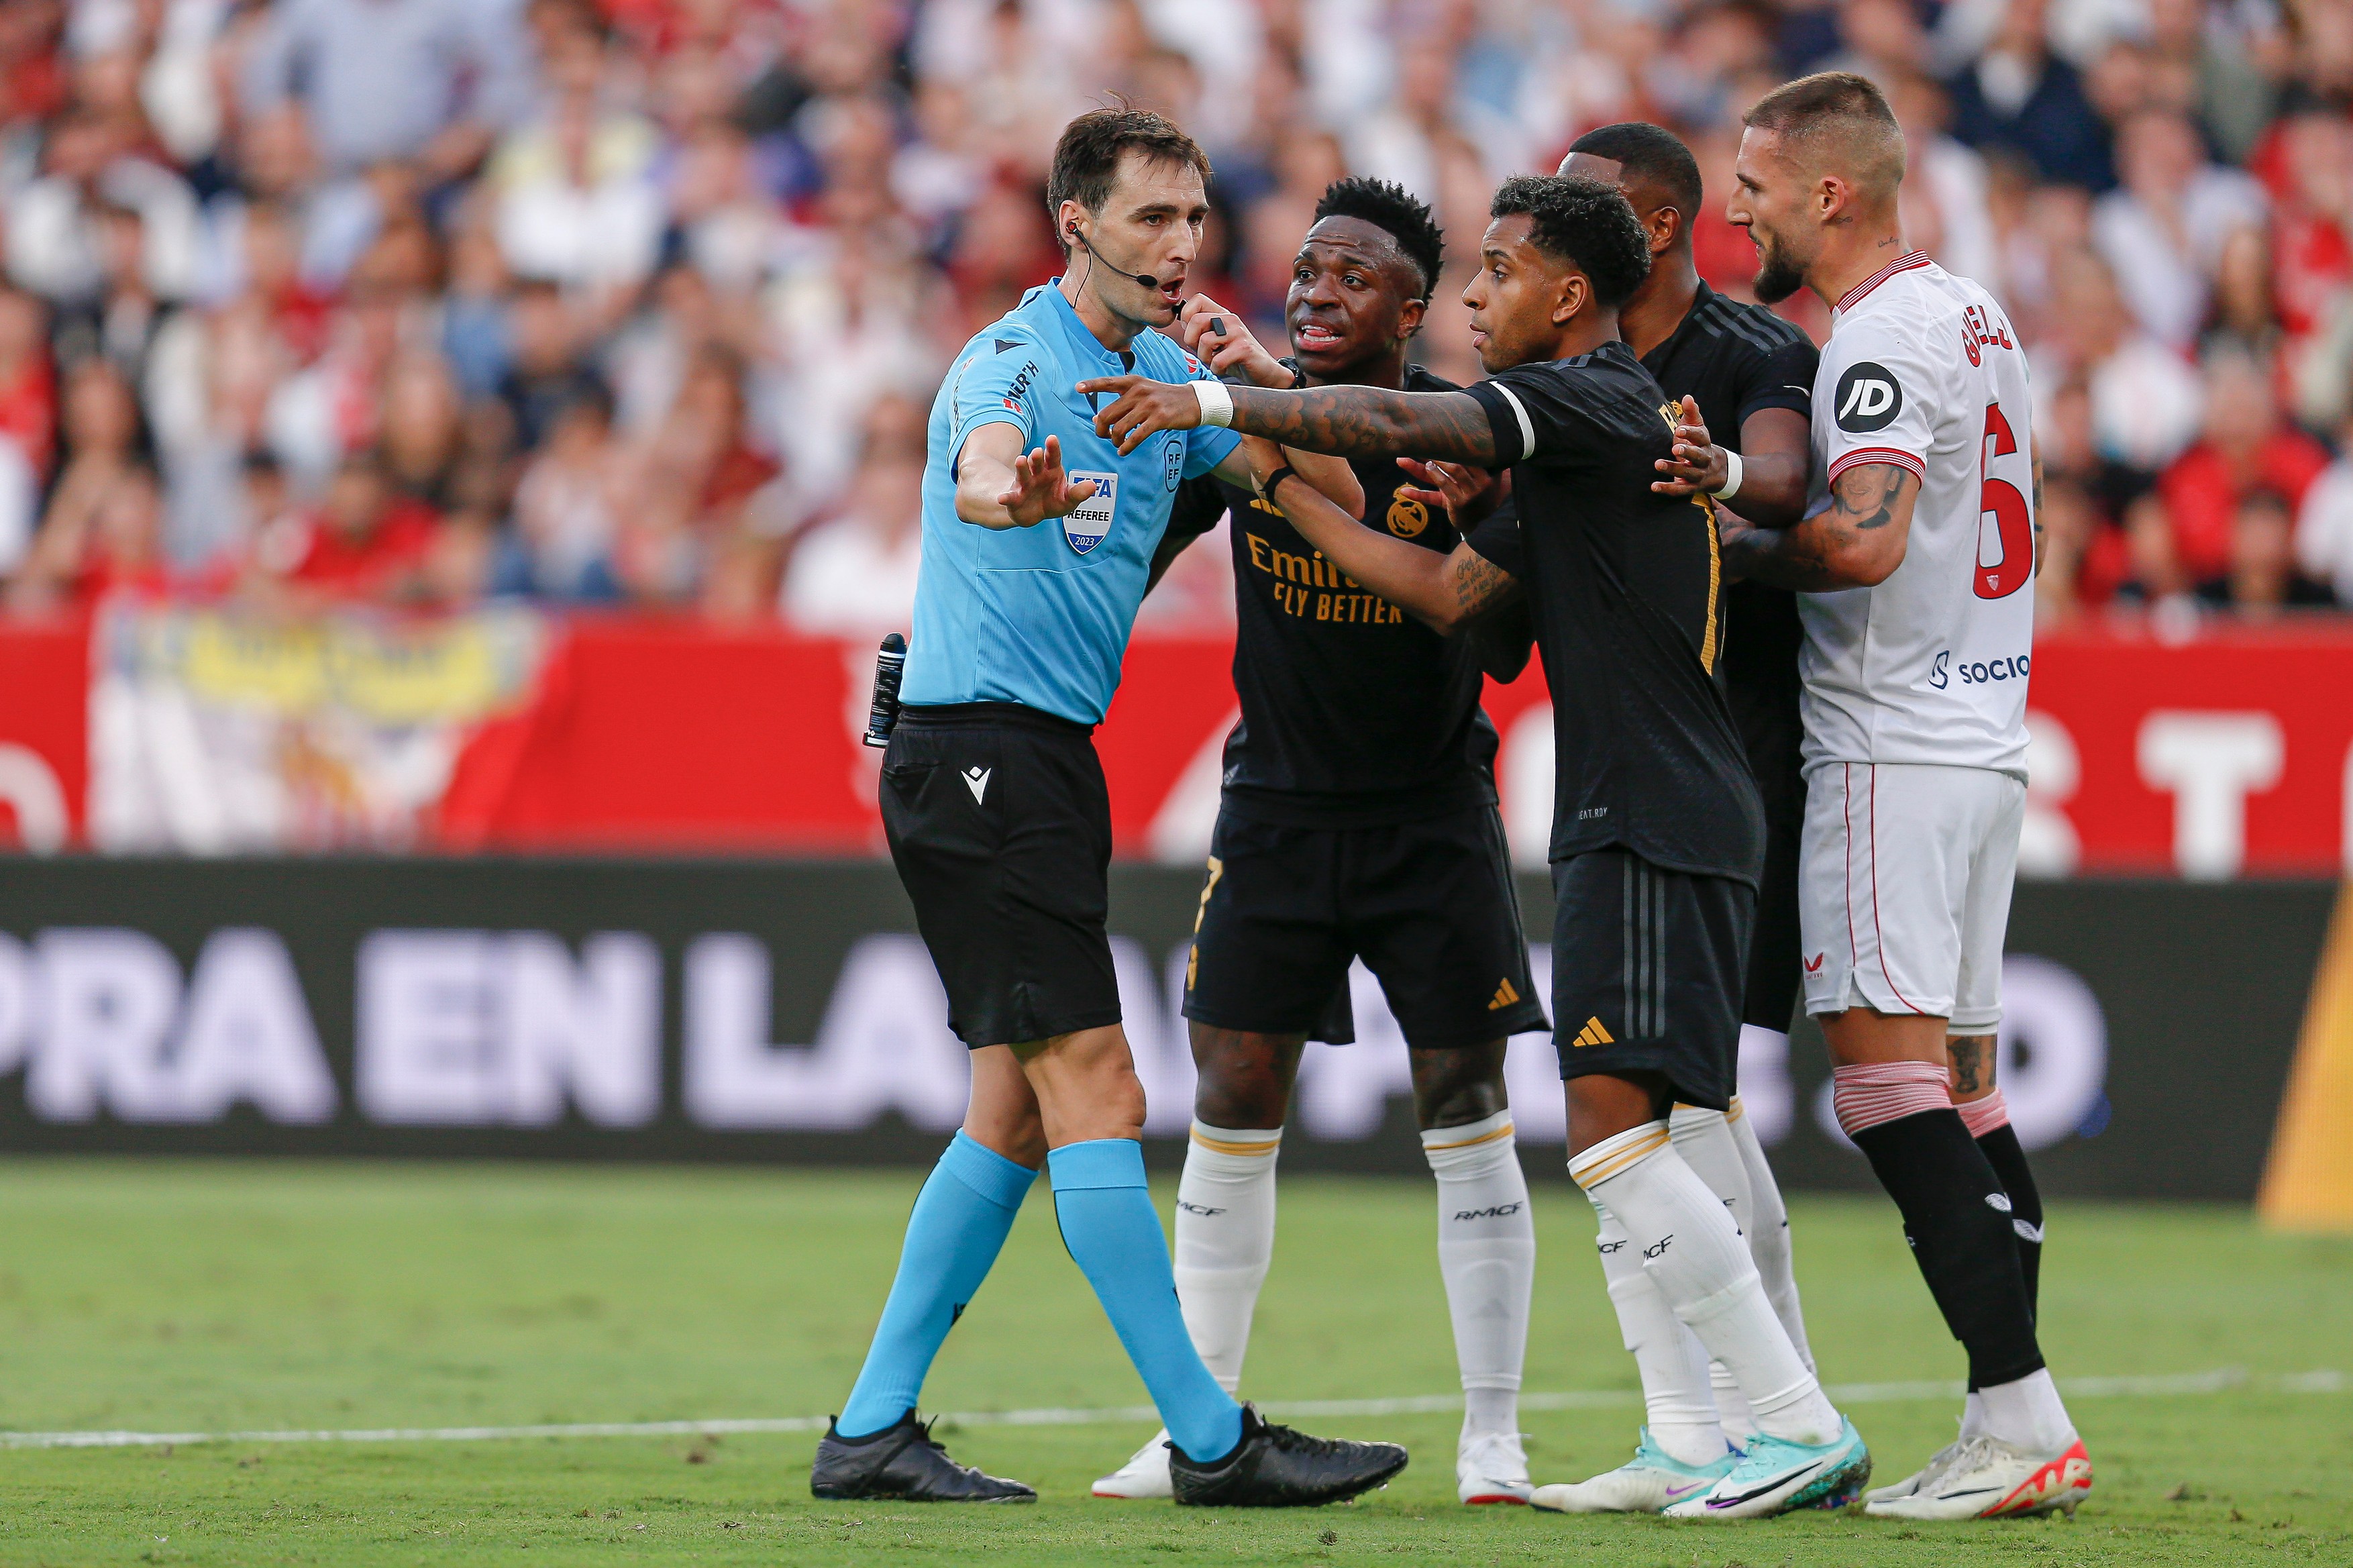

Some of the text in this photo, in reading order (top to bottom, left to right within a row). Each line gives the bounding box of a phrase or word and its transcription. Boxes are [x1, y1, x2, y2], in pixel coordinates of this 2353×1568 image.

[1838, 379, 1895, 421] JD
[1168, 453, 1181, 465] RF
[1167, 469, 1180, 480] EF
[1972, 402, 2034, 600] 6
[1067, 509, 1110, 522] REFEREE
[1075, 537, 1095, 546] 2023
[1274, 582, 1403, 624] FLY BETTER
[1958, 655, 2030, 684] SOCIO
[0, 926, 339, 1125] RA
[352, 928, 661, 1129] EN
[1454, 1201, 1523, 1220] RMCF
